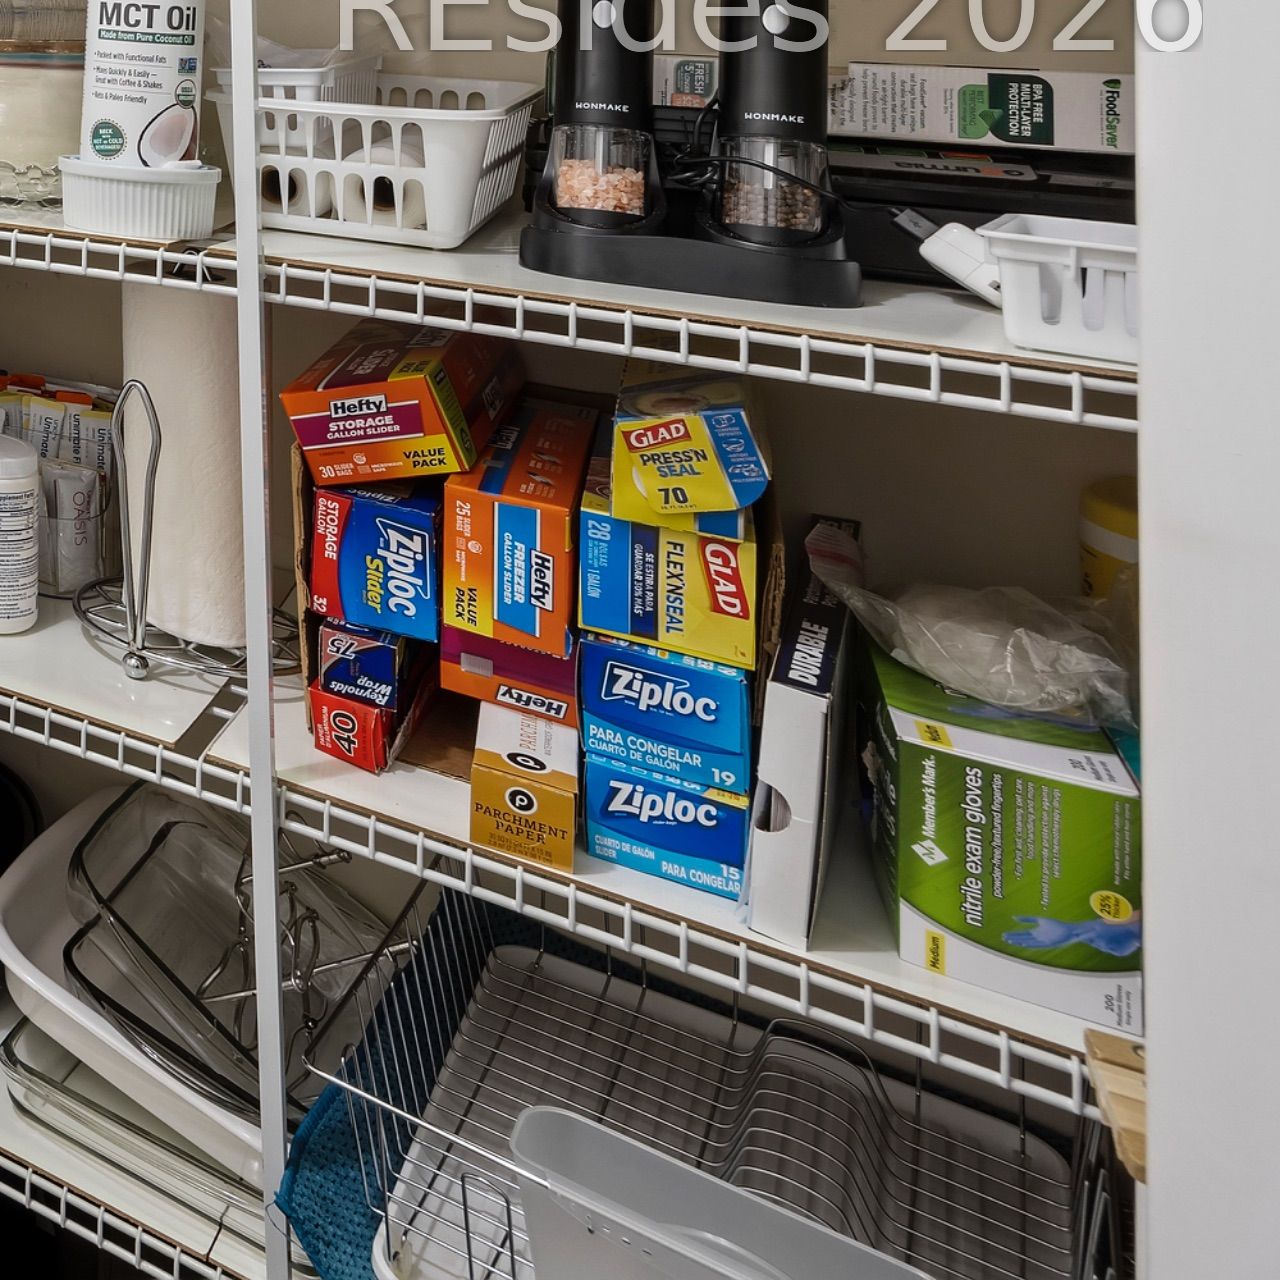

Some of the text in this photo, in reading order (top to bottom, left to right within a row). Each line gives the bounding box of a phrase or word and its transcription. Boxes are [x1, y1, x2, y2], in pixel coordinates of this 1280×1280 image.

[100, 1, 196, 31] MCT Oil
[100, 30, 116, 39] Made
[136, 33, 153, 42] Pure
[155, 34, 183, 43] Coconut
[694, 62, 705, 95] FRESH
[1008, 82, 1020, 136] PROTECTION
[1020, 83, 1032, 137] MULTI-LAYER
[1032, 83, 1043, 124] BPA FREE
[1105, 89, 1121, 149] FoodSaver
[329, 415, 394, 431] STORAGE
[332, 397, 385, 416] Hefty
[40, 416, 54, 459] Unimate
[327, 424, 400, 440] GALLON SLIDER
[630, 423, 685, 448] GLAD
[403, 448, 445, 459] VALUE
[412, 457, 447, 468] PACK
[641, 449, 708, 466] PRESS'N
[319, 466, 335, 478] 30
[656, 464, 702, 478] SEAL
[456, 499, 471, 517] 25
[658, 487, 688, 504] 70
[73, 492, 87, 546] OASIS
[317, 498, 326, 535] GALLON
[324, 500, 339, 560] STORAGE
[587, 520, 611, 541] 28
[377, 528, 423, 616] Ziploc
[504, 532, 512, 605] GALLON SLIDER
[514, 540, 526, 604] FREEZER
[634, 544, 643, 580] GUARDAR
[704, 542, 742, 615] GLAD
[365, 555, 385, 614] Slider
[531, 553, 551, 609] Hefty
[634, 581, 643, 597] 30%
[645, 552, 654, 611] SE ESTIRA PARA
[313, 595, 327, 613] 32
[455, 587, 466, 620] PACK
[467, 587, 477, 626] VALUE
[327, 636, 358, 659] 75
[788, 621, 829, 686] DURABLE
[329, 681, 389, 705] Reynolds
[357, 677, 392, 696] Wrap
[500, 688, 564, 716] Hefty
[612, 668, 717, 722] Ziploc
[330, 710, 358, 757] 40
[589, 724, 701, 767] PARA CONGELAR
[588, 738, 680, 772] CUARTO DE GALÓN
[712, 768, 736, 786] 19
[991, 773, 1004, 812] fingertips
[608, 780, 718, 827] Ziploc
[921, 786, 937, 838] Member's
[475, 802, 568, 840] PARCHMENT
[495, 820, 546, 844] PAPER
[595, 834, 621, 850] CUARTO
[622, 841, 630, 853] DE
[961, 766, 986, 927] nitrile exam gloves
[662, 861, 741, 893] PARA CONGELAR
[720, 864, 740, 880] 15
[1099, 895, 1112, 916] 25%
[929, 936, 940, 970] Medium
[1104, 994, 1115, 1012] 200
